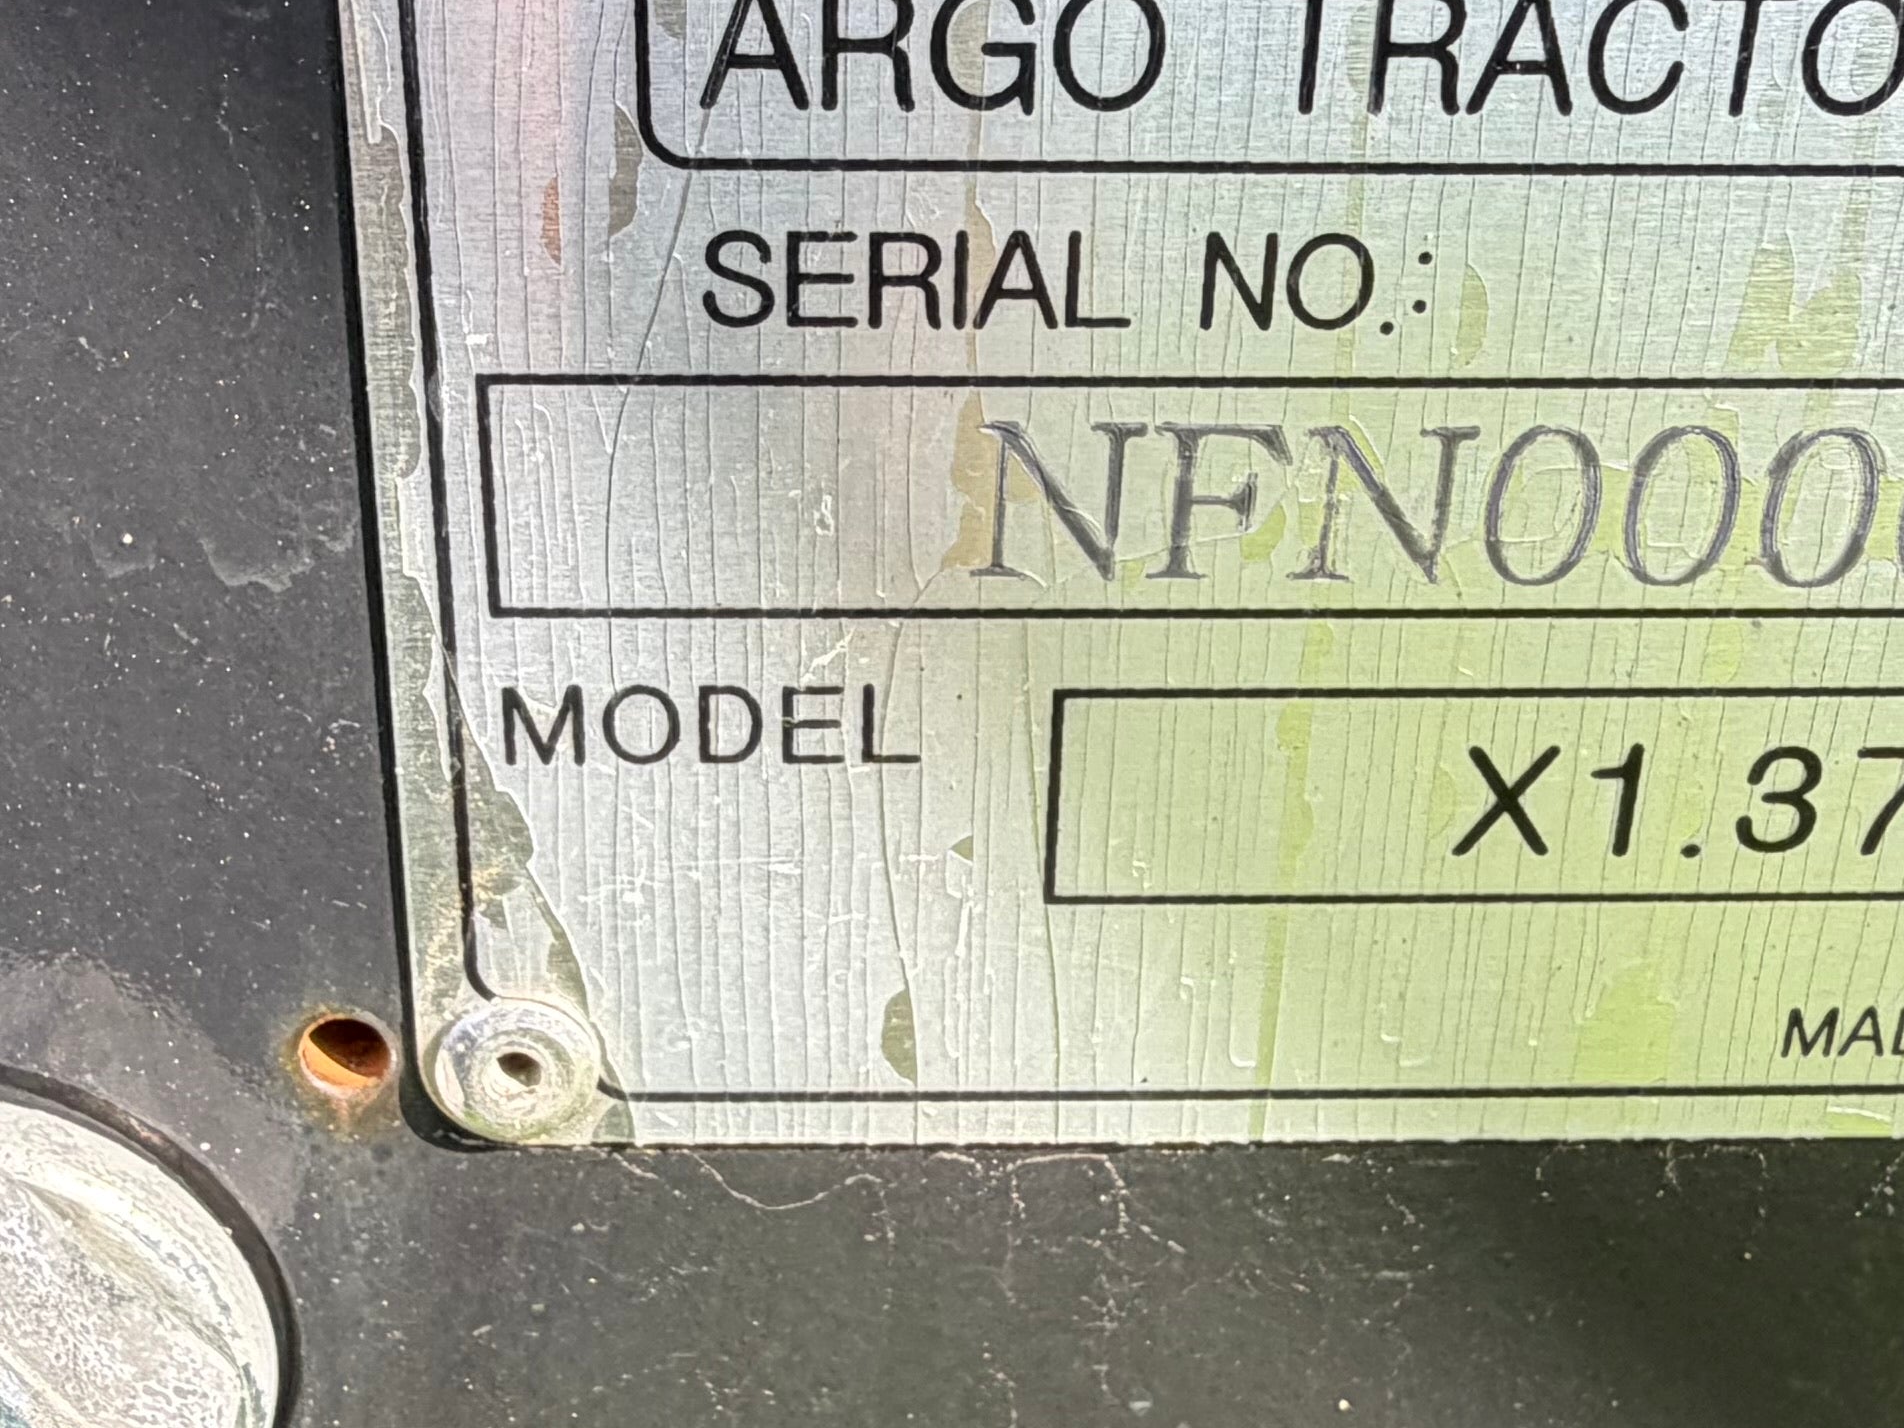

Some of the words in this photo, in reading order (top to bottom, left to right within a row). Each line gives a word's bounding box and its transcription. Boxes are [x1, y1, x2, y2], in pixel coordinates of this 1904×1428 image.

[702, 228, 1132, 330] SERIAL
[1200, 231, 1432, 335] NO.:
[501, 683, 921, 765] MODEL
